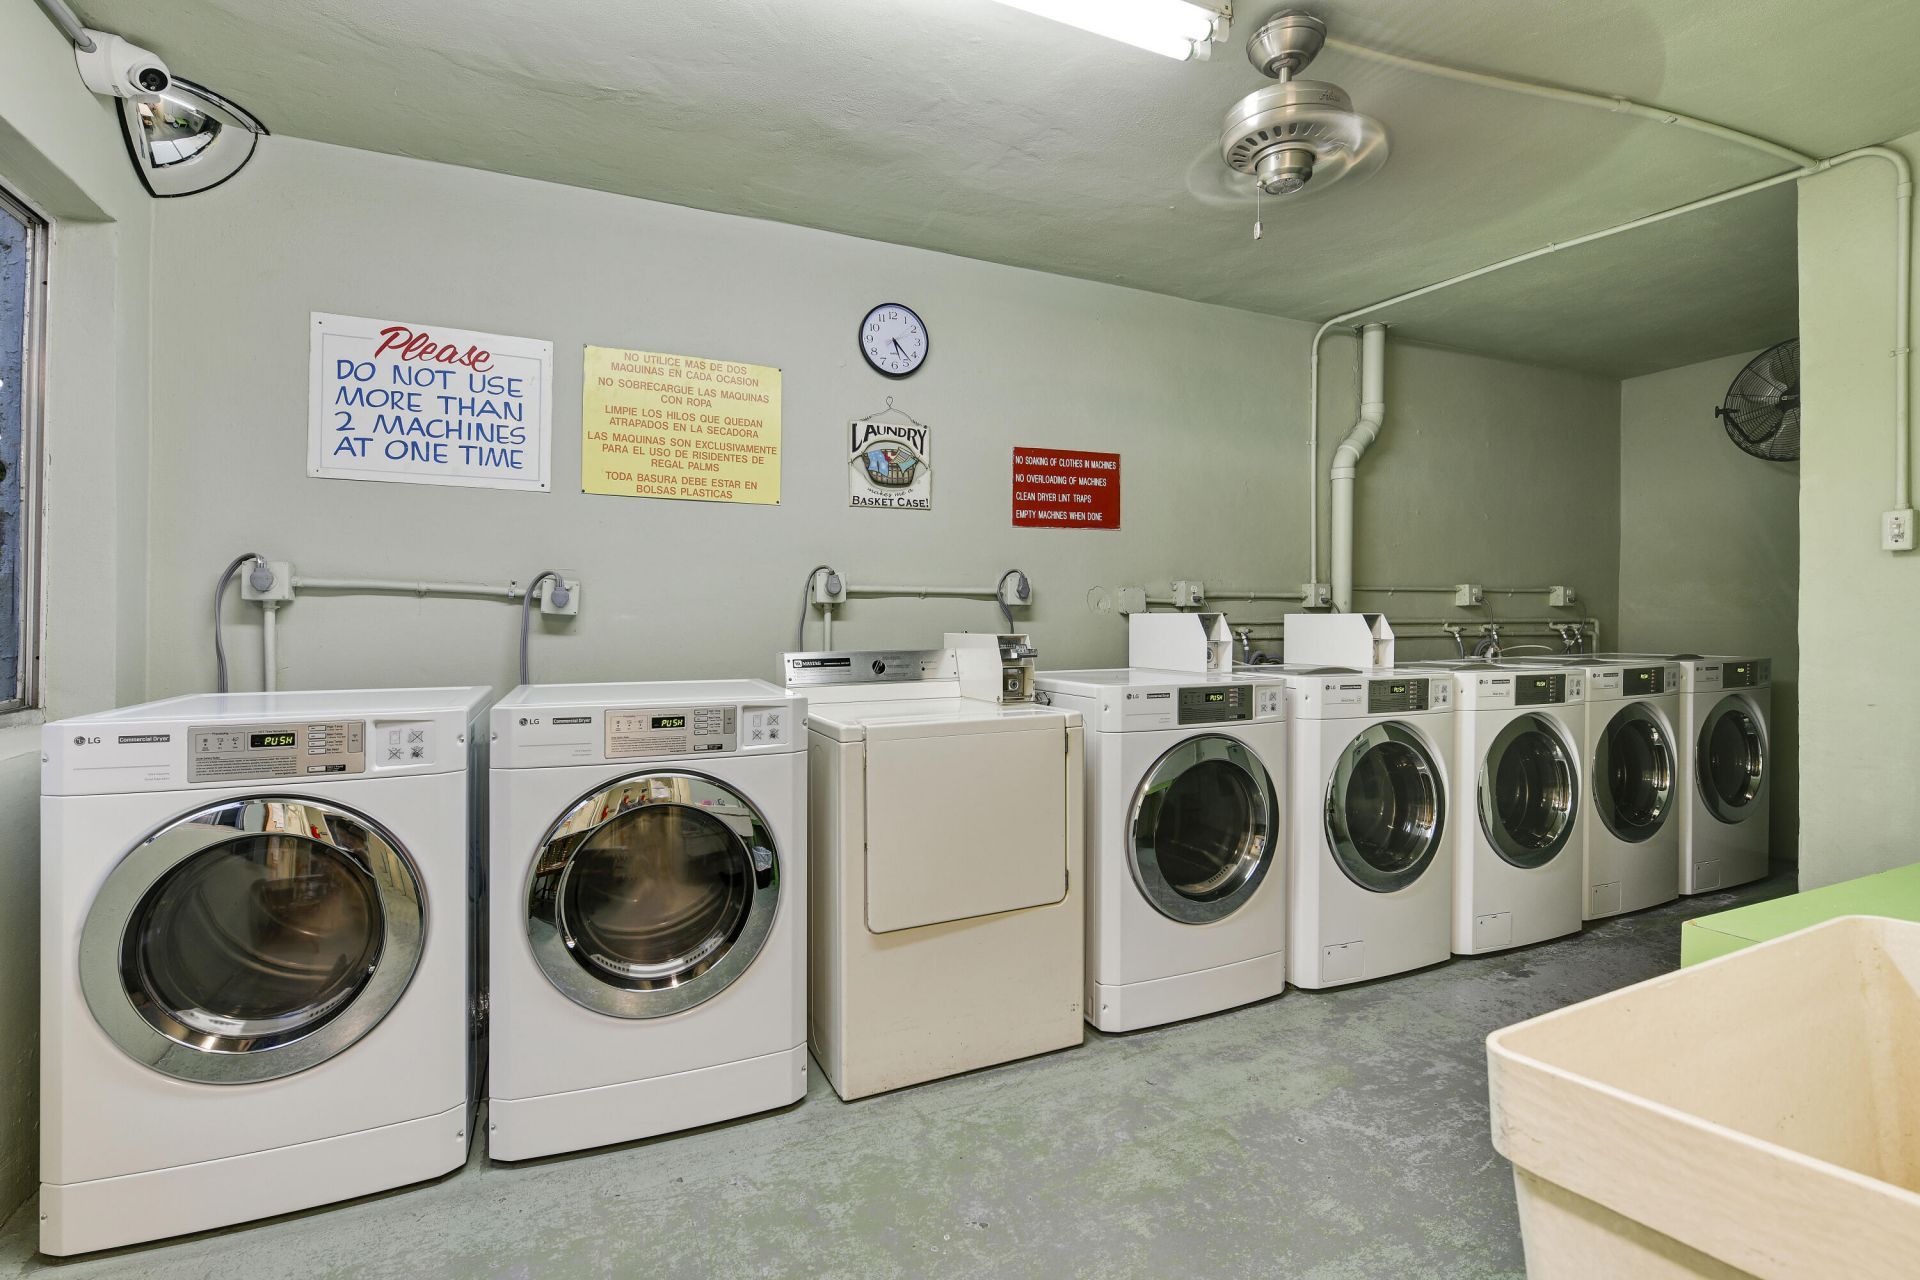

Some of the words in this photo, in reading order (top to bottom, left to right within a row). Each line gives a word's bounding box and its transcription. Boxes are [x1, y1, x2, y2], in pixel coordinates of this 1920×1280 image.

[374, 326, 494, 373] Please
[624, 352, 640, 362] NO
[643, 355, 681, 366] UTILICE
[685, 360, 706, 370] MAS
[710, 363, 723, 372] DE
[727, 365, 748, 375] DOS
[337, 359, 376, 382] DO
[393, 364, 456, 390] NOT
[469, 373, 523, 398] USE
[611, 362, 664, 376] MAQUINAS
[669, 369, 682, 378] EN
[686, 371, 712, 382] CADA
[716, 374, 759, 387] OCASION
[598, 377, 614, 387] NO
[618, 379, 694, 395] SOBRECARGUE
[698, 388, 717, 398] LAS
[720, 391, 770, 404] MAQUINAS
[335, 386, 423, 413] MORE
[437, 395, 523, 422] THAN
[661, 395, 683, 405] CON
[687, 398, 712, 408] ROPA
[605, 405, 638, 416] LIMPIE
[642, 408, 662, 419] LOS
[667, 411, 696, 422] HILOS
[700, 414, 720, 424] QUE
[724, 417, 763, 428] QUEDAN
[334, 411, 356, 432] 2
[372, 414, 526, 445] MACHINES
[609, 417, 669, 431] ATRAPADOS
[673, 423, 687, 432] EN
[690, 425, 704, 434] LA
[707, 425, 759, 439] SECADORA
[587, 431, 608, 441] LAS
[612, 433, 666, 446] MAQUINAS
[670, 438, 692, 448] SON
[695, 440, 778, 456] EXCLUSIVAMENTE
[851, 423, 927, 456] LAUNDRY
[333, 436, 374, 457] AT
[384, 439, 448, 464] ONE
[458, 445, 524, 470] TIME
[602, 444, 629, 454] PARA
[633, 446, 646, 455] EL
[649, 448, 672, 458] USO
[675, 450, 689, 459] DE
[692, 451, 749, 464] RISIDENTES
[752, 456, 765, 465] DE
[1015, 455, 1024, 465] NO
[1025, 456, 1049, 466] SOAKING
[1050, 458, 1058, 466] OF
[1058, 458, 1083, 468] CLOTHES
[1084, 460, 1090, 469] IN
[1091, 460, 1117, 470] MACHINES
[651, 459, 685, 470] REGAL
[688, 461, 720, 472] PALMS
[606, 471, 633, 482] TODA
[637, 473, 678, 484] BASURA
[681, 476, 708, 486] DEBE
[712, 479, 741, 489] ESTAR
[745, 481, 758, 490] EN
[1015, 473, 1025, 483] NO
[1026, 474, 1067, 485] OVERLOADING
[1068, 476, 1078, 485] OF
[1079, 477, 1107, 487] MACHINES
[636, 485, 677, 496] BOLSAS
[680, 488, 733, 499] PLASTICAS
[852, 495, 895, 507] BASKET
[897, 497, 929, 508] CASE!
[1015, 491, 1036, 501] CLEAN
[1038, 492, 1057, 502] DRYER
[1058, 493, 1071, 502] LINT
[1073, 494, 1092, 504] TRAPS
[1015, 509, 1037, 519] EMPTY
[1038, 511, 1068, 520] MACHINES
[1069, 511, 1086, 520] WHEN
[1087, 512, 1103, 521] DONE
[661, 719, 683, 727] PUSH
[87, 737, 101, 745] LG
[119, 736, 152, 744] Commercial
[153, 735, 170, 743] Dryer
[264, 736, 293, 746] PUSH
